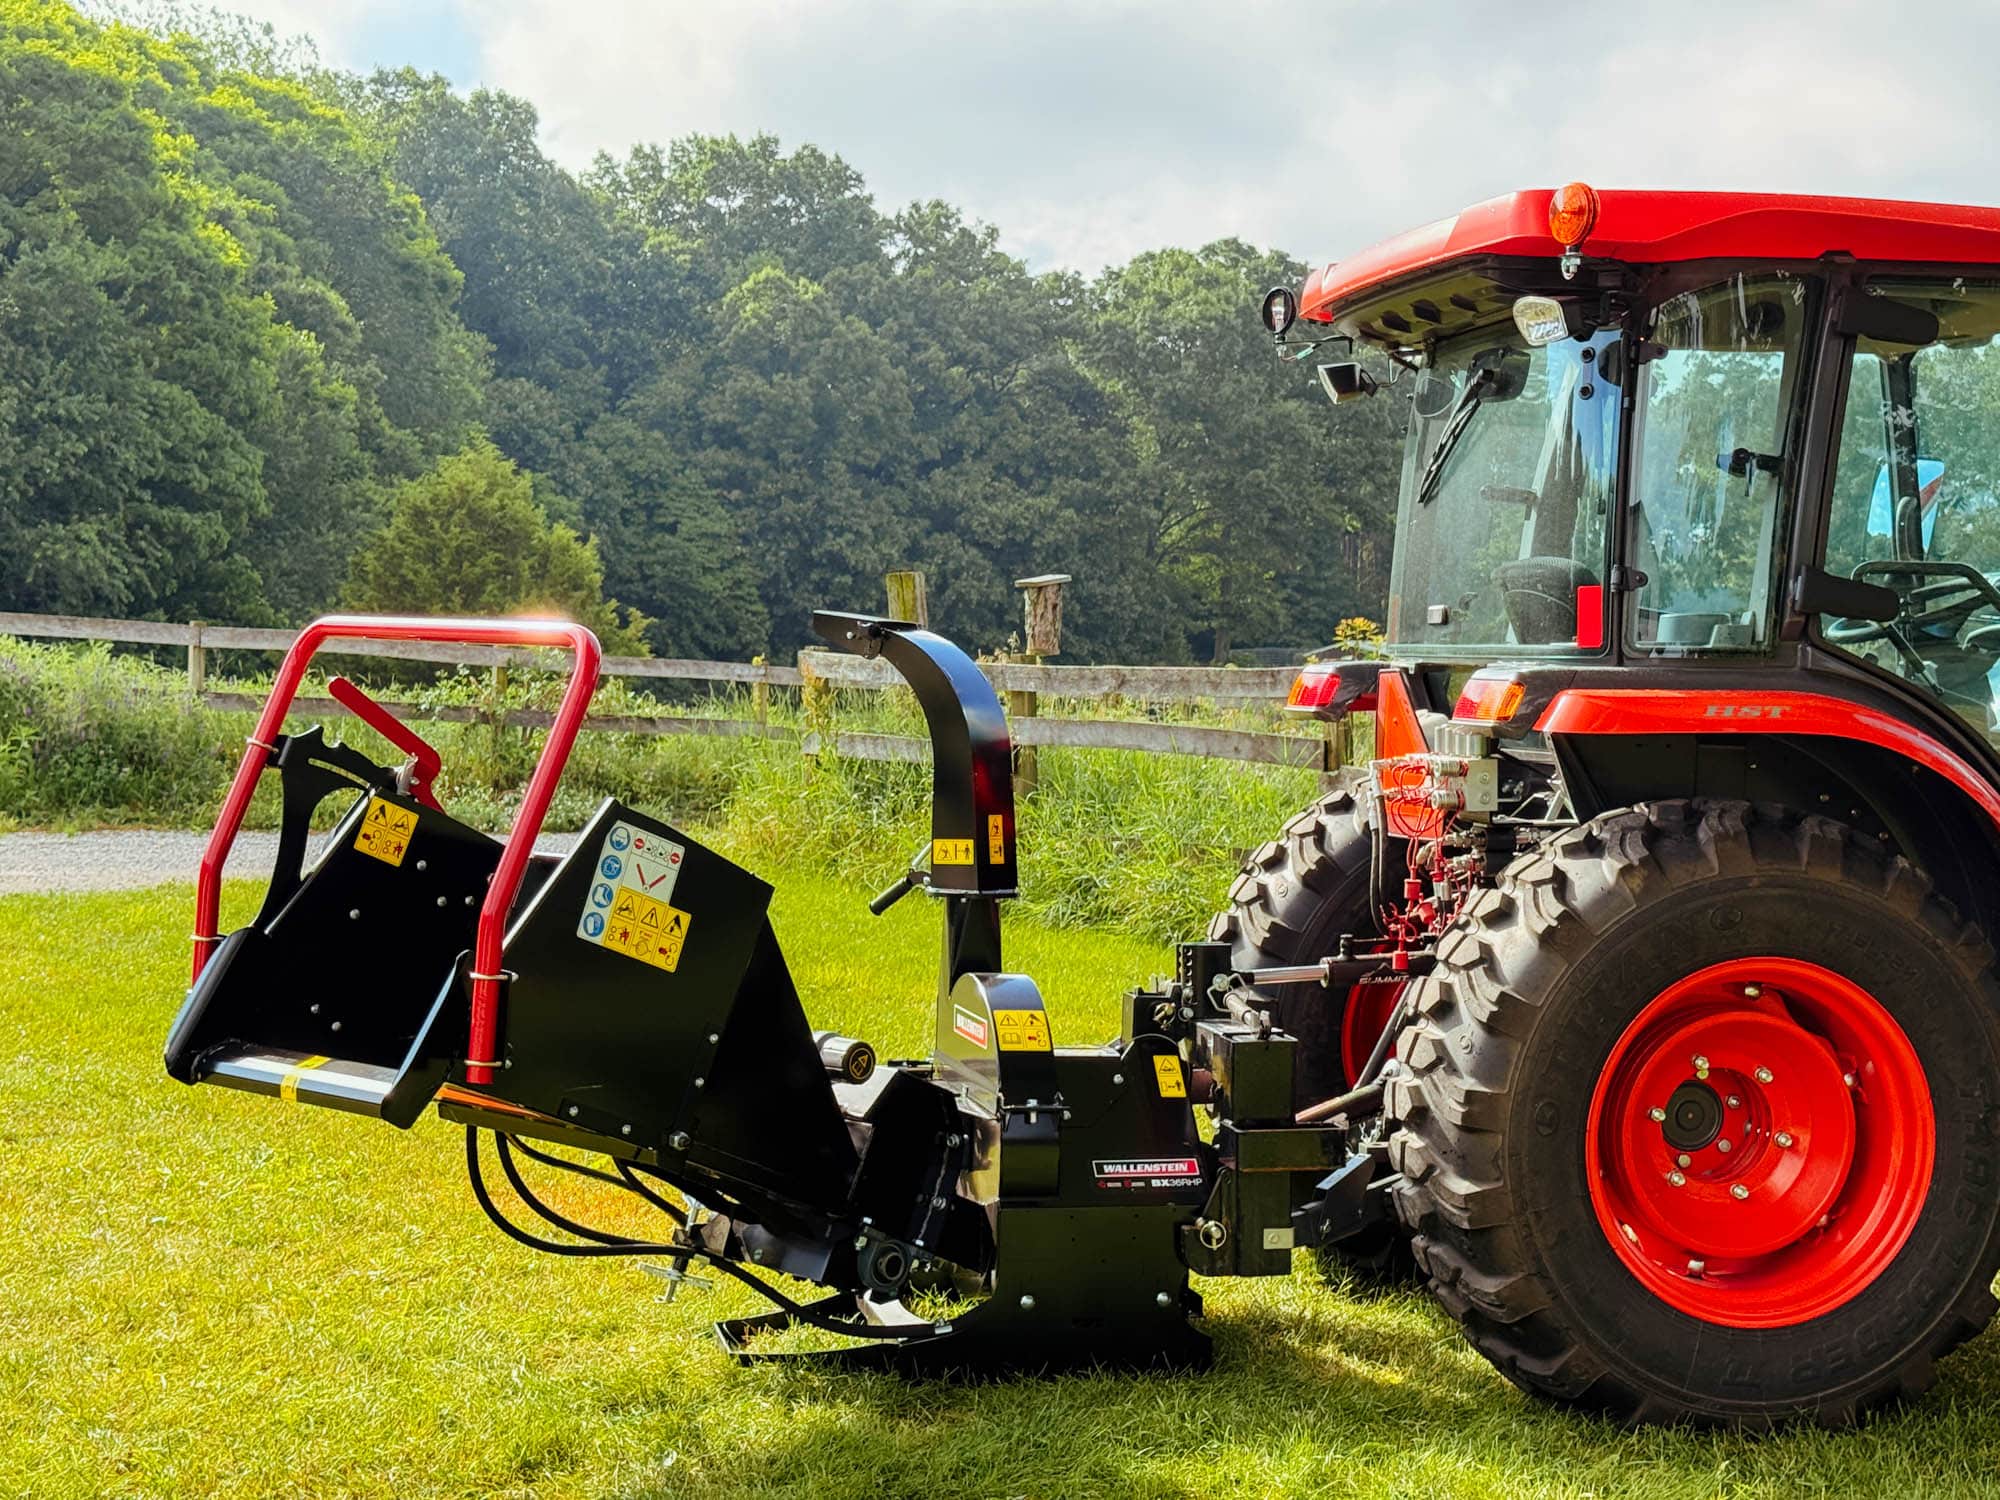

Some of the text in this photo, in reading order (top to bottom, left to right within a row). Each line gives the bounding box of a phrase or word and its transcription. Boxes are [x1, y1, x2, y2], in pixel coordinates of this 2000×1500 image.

[1704, 705, 1792, 718] HST
[1359, 975, 1409, 984] SUMMIT
[1103, 1163, 1188, 1173] WALLENSTEIN
